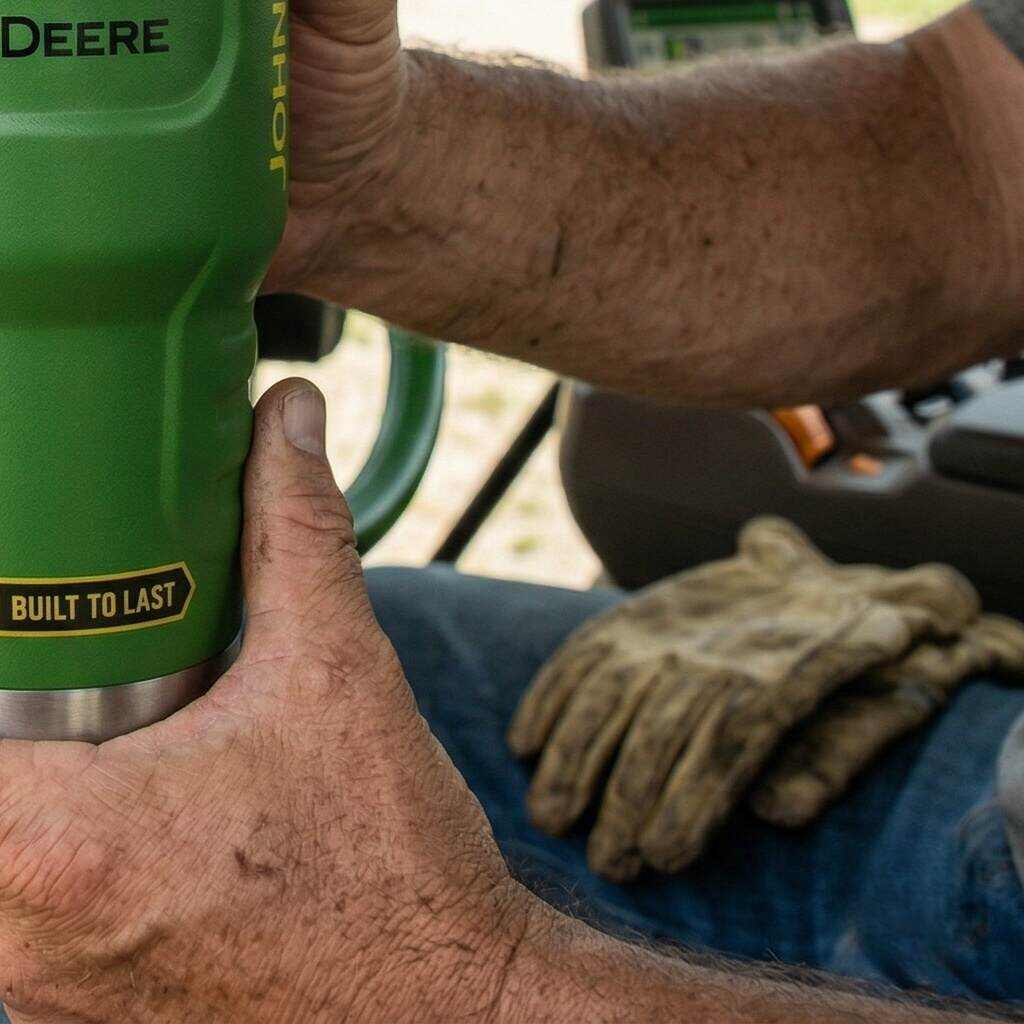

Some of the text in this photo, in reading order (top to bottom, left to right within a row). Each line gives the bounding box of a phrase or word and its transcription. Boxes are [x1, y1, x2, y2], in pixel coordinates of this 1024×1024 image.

[1, 16, 170, 58] DEERE
[269, 2, 286, 190] JOHN
[12, 594, 79, 621] BUILT
[87, 592, 116, 619] TO
[123, 581, 176, 615] LAST
